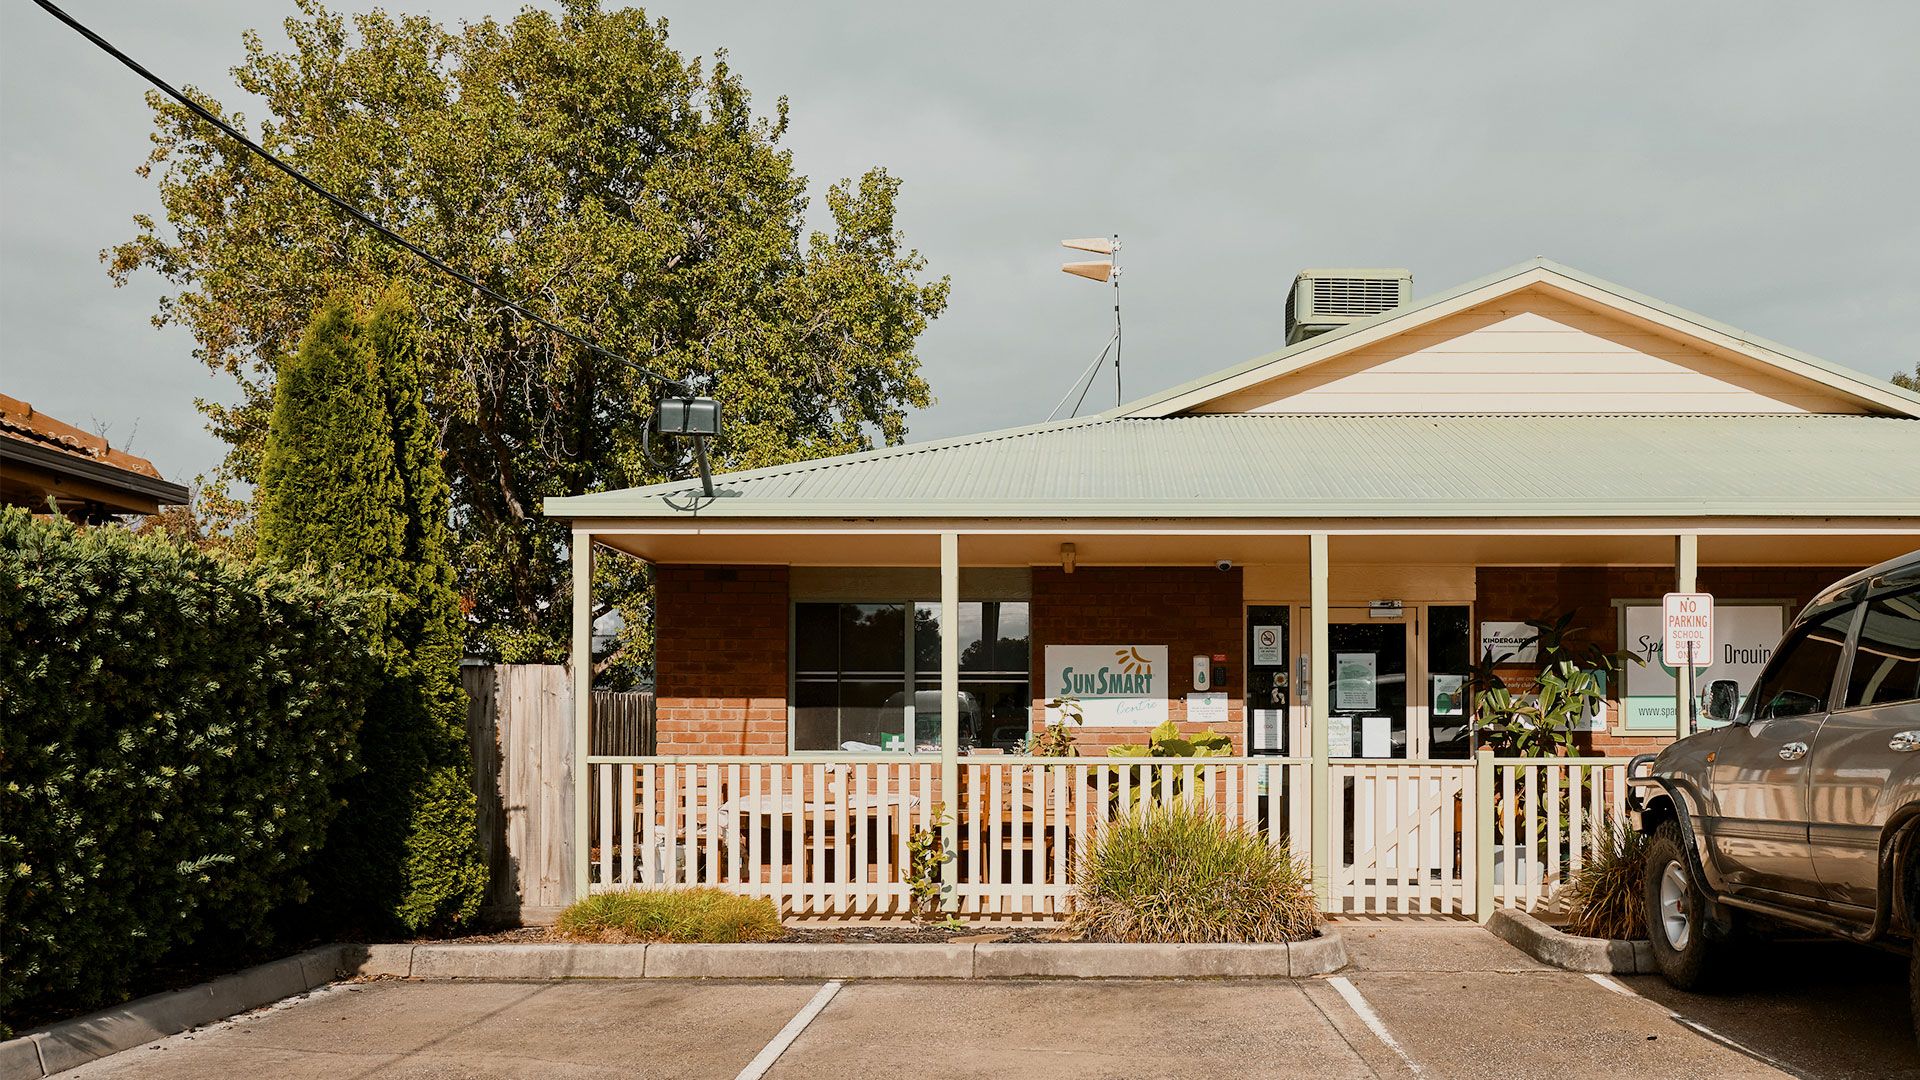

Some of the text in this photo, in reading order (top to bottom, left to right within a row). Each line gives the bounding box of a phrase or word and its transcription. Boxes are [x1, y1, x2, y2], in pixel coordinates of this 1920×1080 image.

[1680, 601, 1696, 613] NO
[1669, 615, 1707, 628] PARKING
[1672, 630, 1704, 639] SCHOOL
[1675, 640, 1702, 649] BUES
[1677, 650, 1699, 659] ONY
[1725, 643, 1771, 664] Drouin
[1116, 697, 1157, 715] Centre
